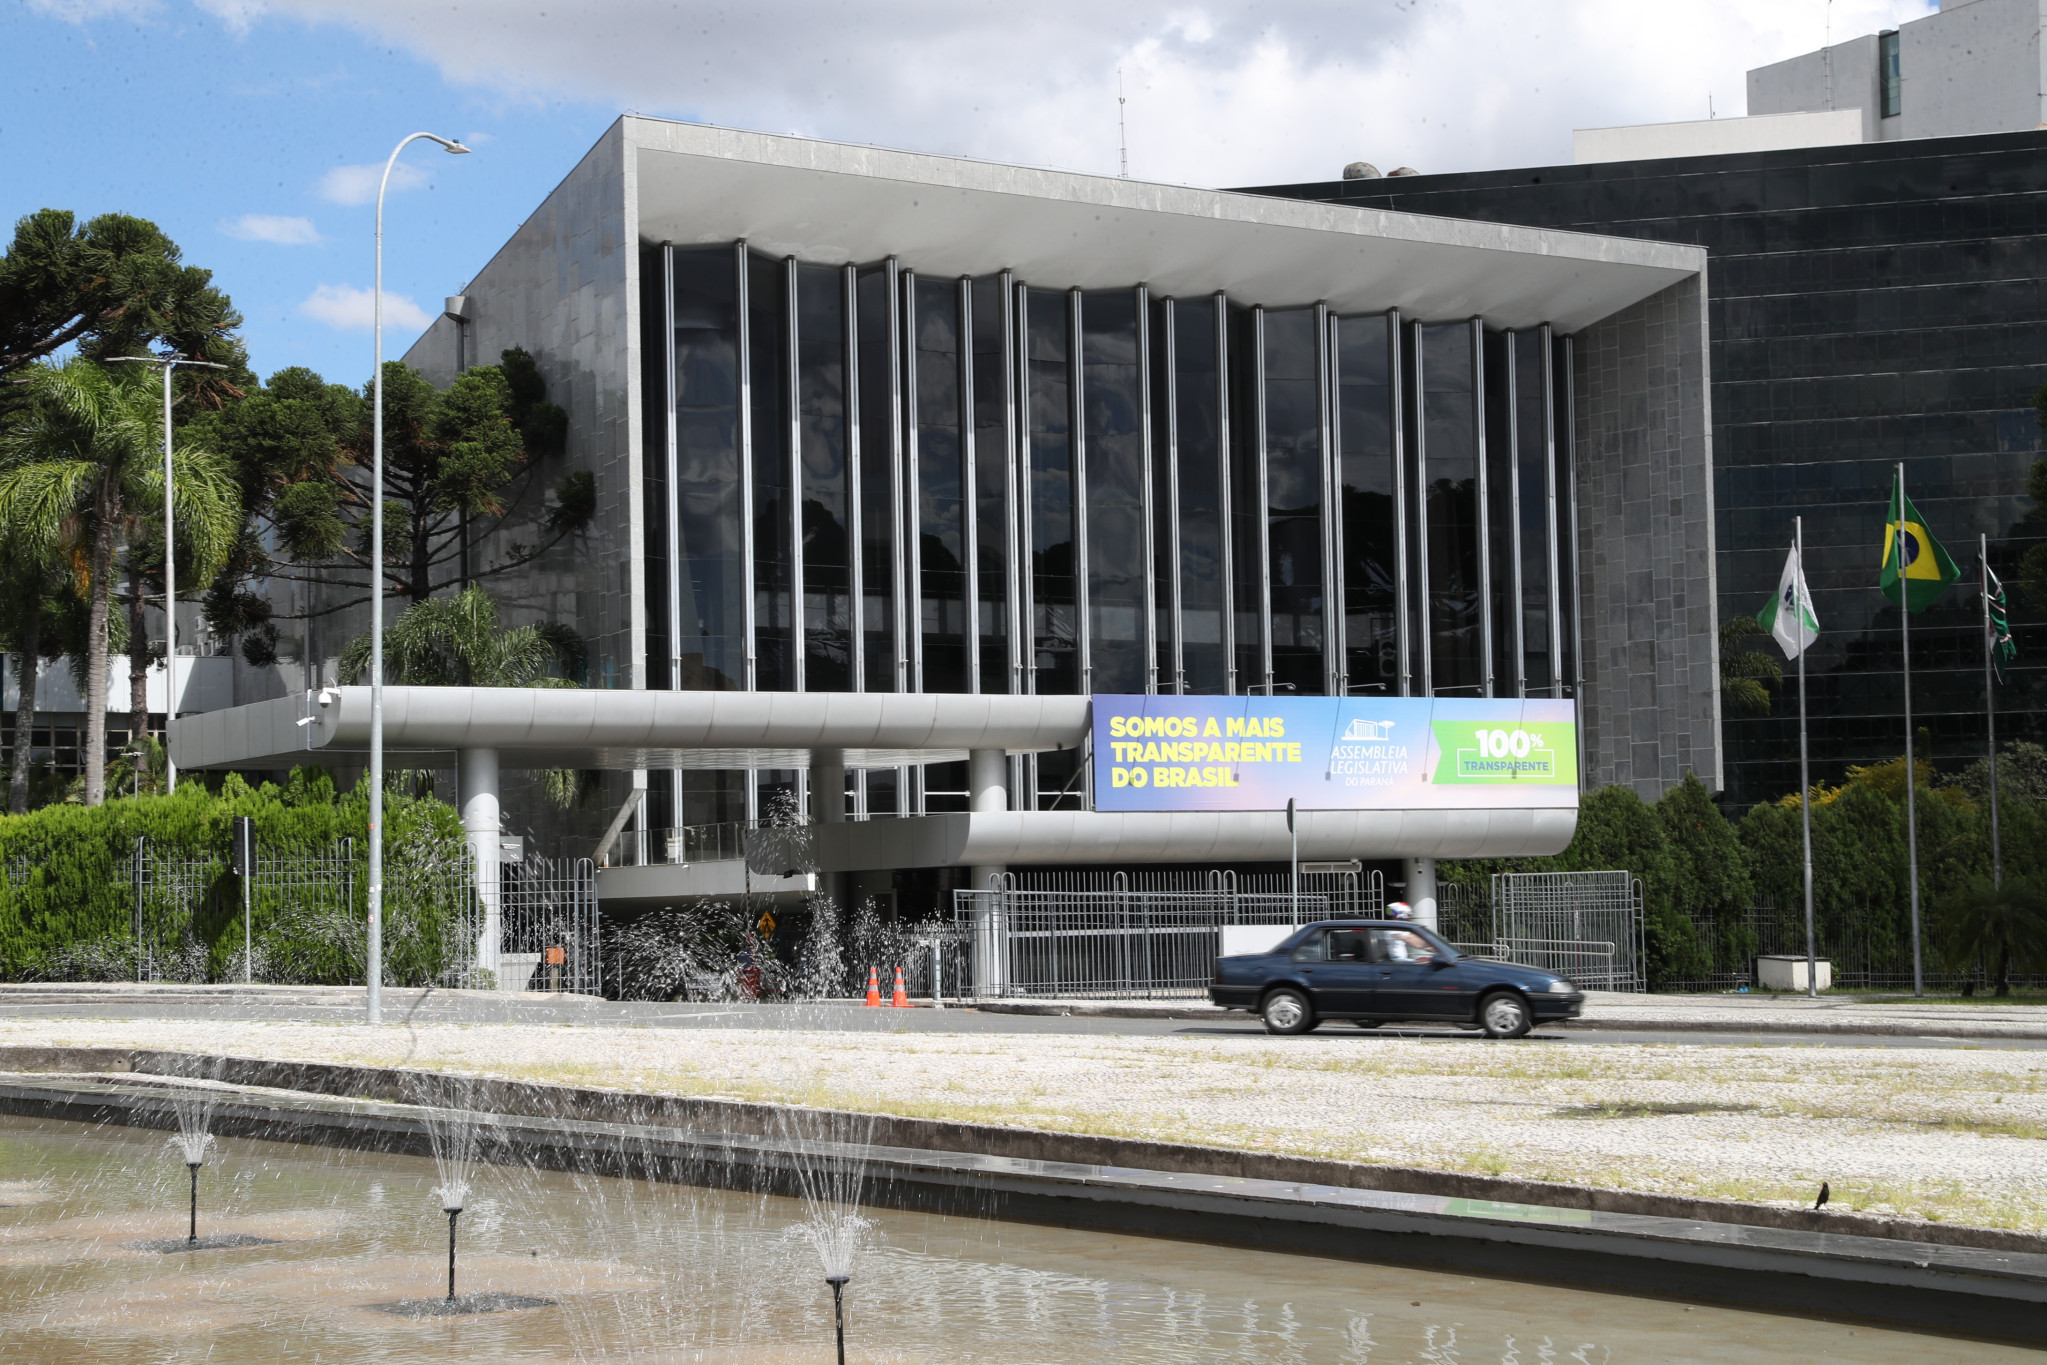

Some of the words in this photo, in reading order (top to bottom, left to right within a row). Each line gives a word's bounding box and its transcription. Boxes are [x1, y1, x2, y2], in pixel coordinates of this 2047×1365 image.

[1110, 716, 1198, 738] SOMOS
[1203, 717, 1221, 738] A
[1226, 717, 1284, 738] MAIS
[1475, 729, 1544, 758] 100%
[1110, 742, 1302, 762] TRANSPARENTE
[1330, 746, 1408, 759] ASSEMBLEIA
[1330, 761, 1408, 774] LEGISLATIVA
[1464, 761, 1548, 771] TRANSPARENTE
[1112, 766, 1148, 788] DO
[1153, 767, 1238, 788] BRASIL
[1346, 777, 1358, 786] DO
[1360, 776, 1394, 786] PARANÁ
